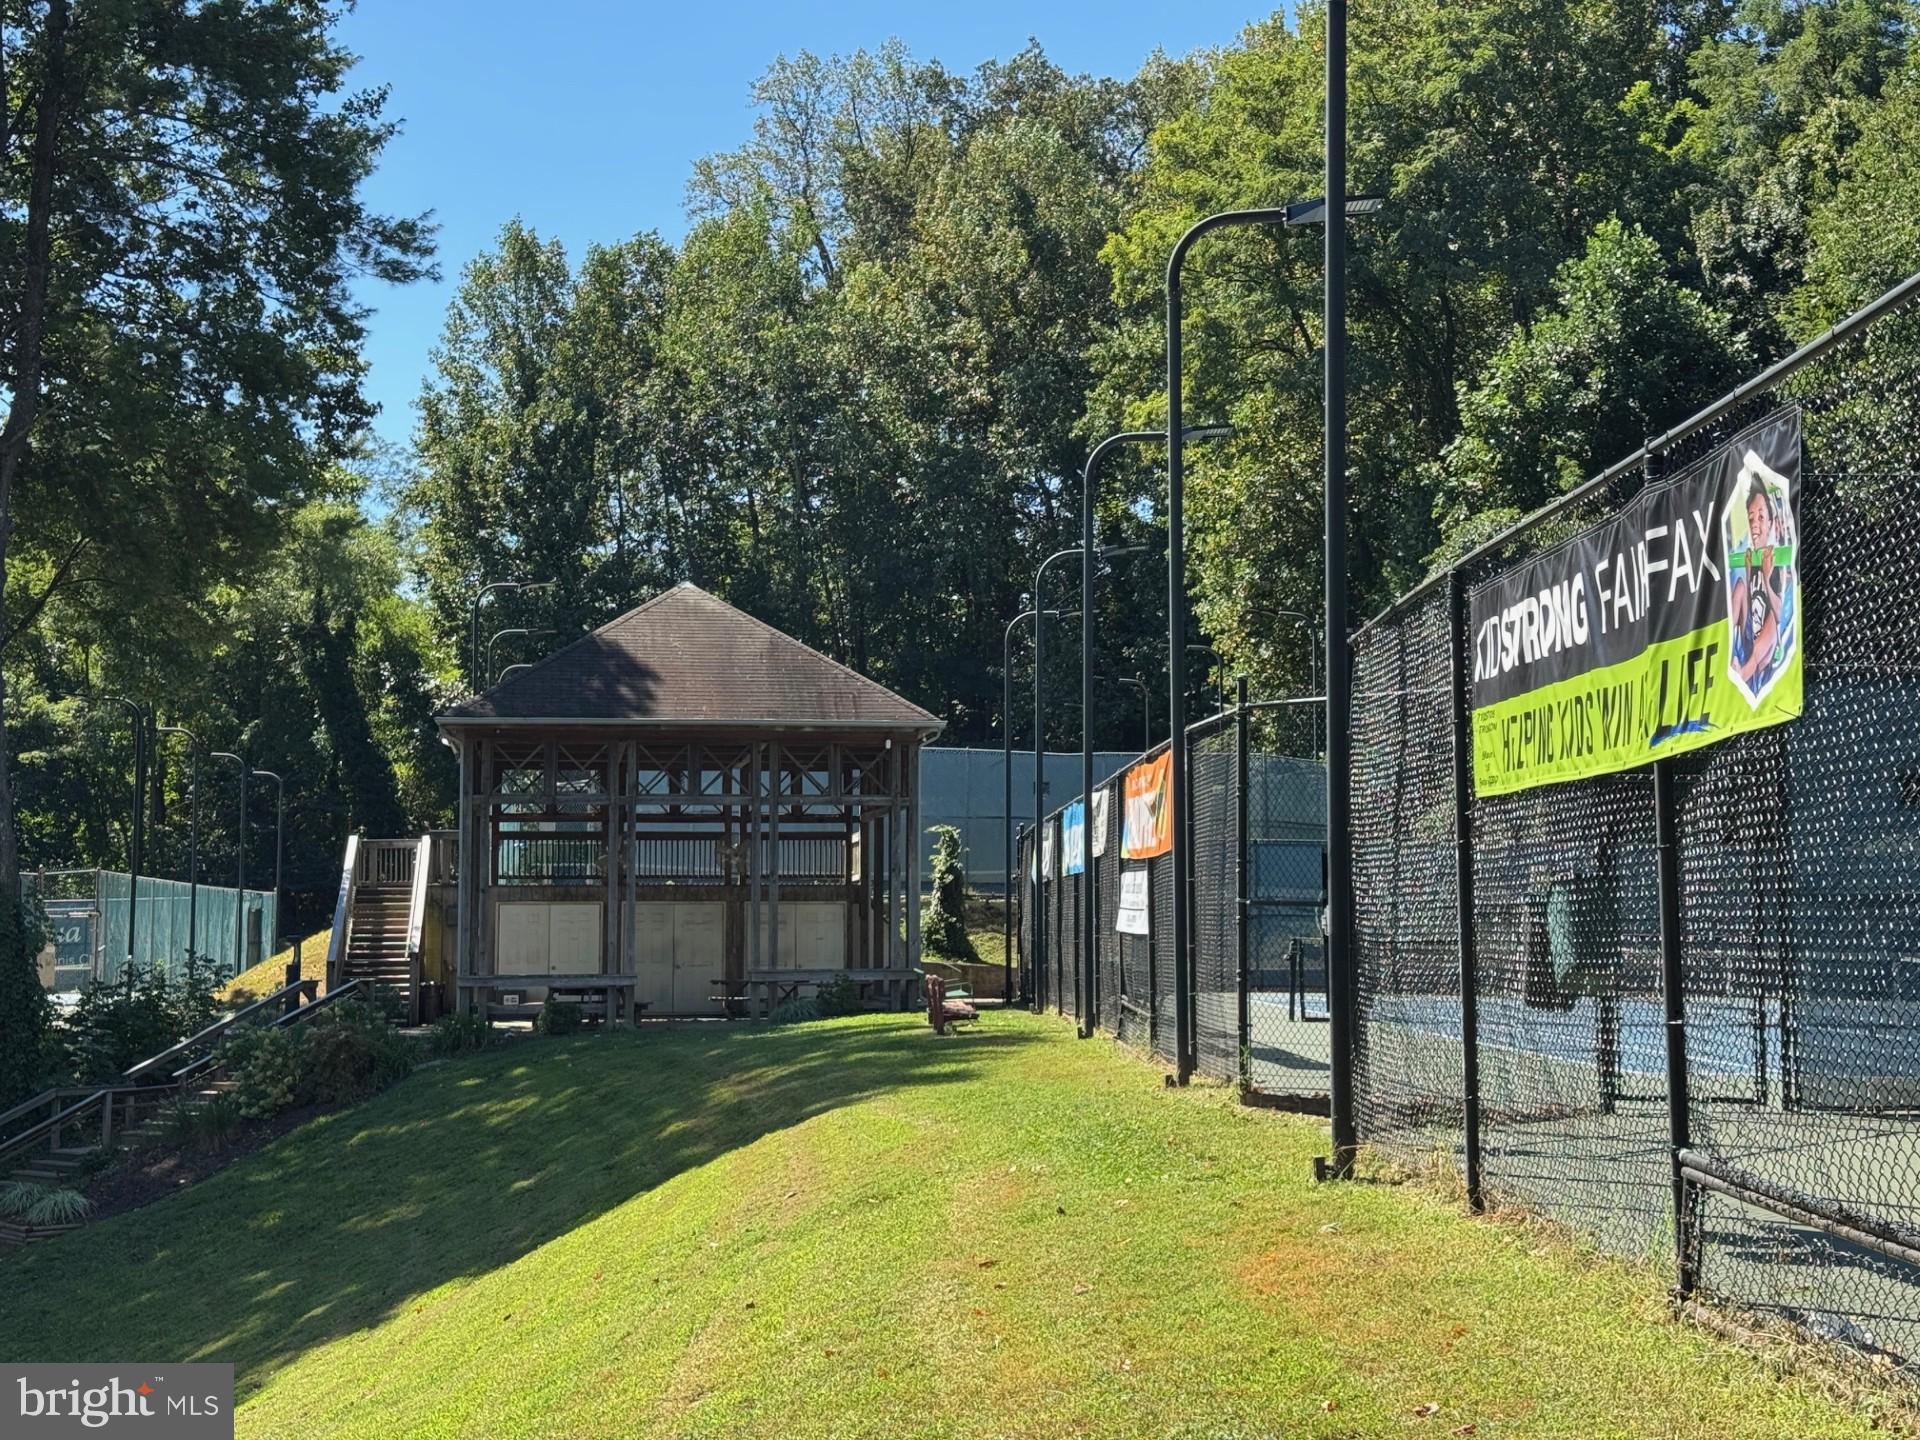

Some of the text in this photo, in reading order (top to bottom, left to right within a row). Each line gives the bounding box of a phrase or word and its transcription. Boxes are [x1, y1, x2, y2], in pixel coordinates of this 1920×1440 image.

[1474, 501, 1721, 682] KIDSTRONG FAIRFAX
[1501, 704, 1554, 773] HELPING
[1558, 691, 1593, 760] KIDS
[1597, 680, 1633, 751] WIN
[1656, 642, 1718, 738] LIFE
